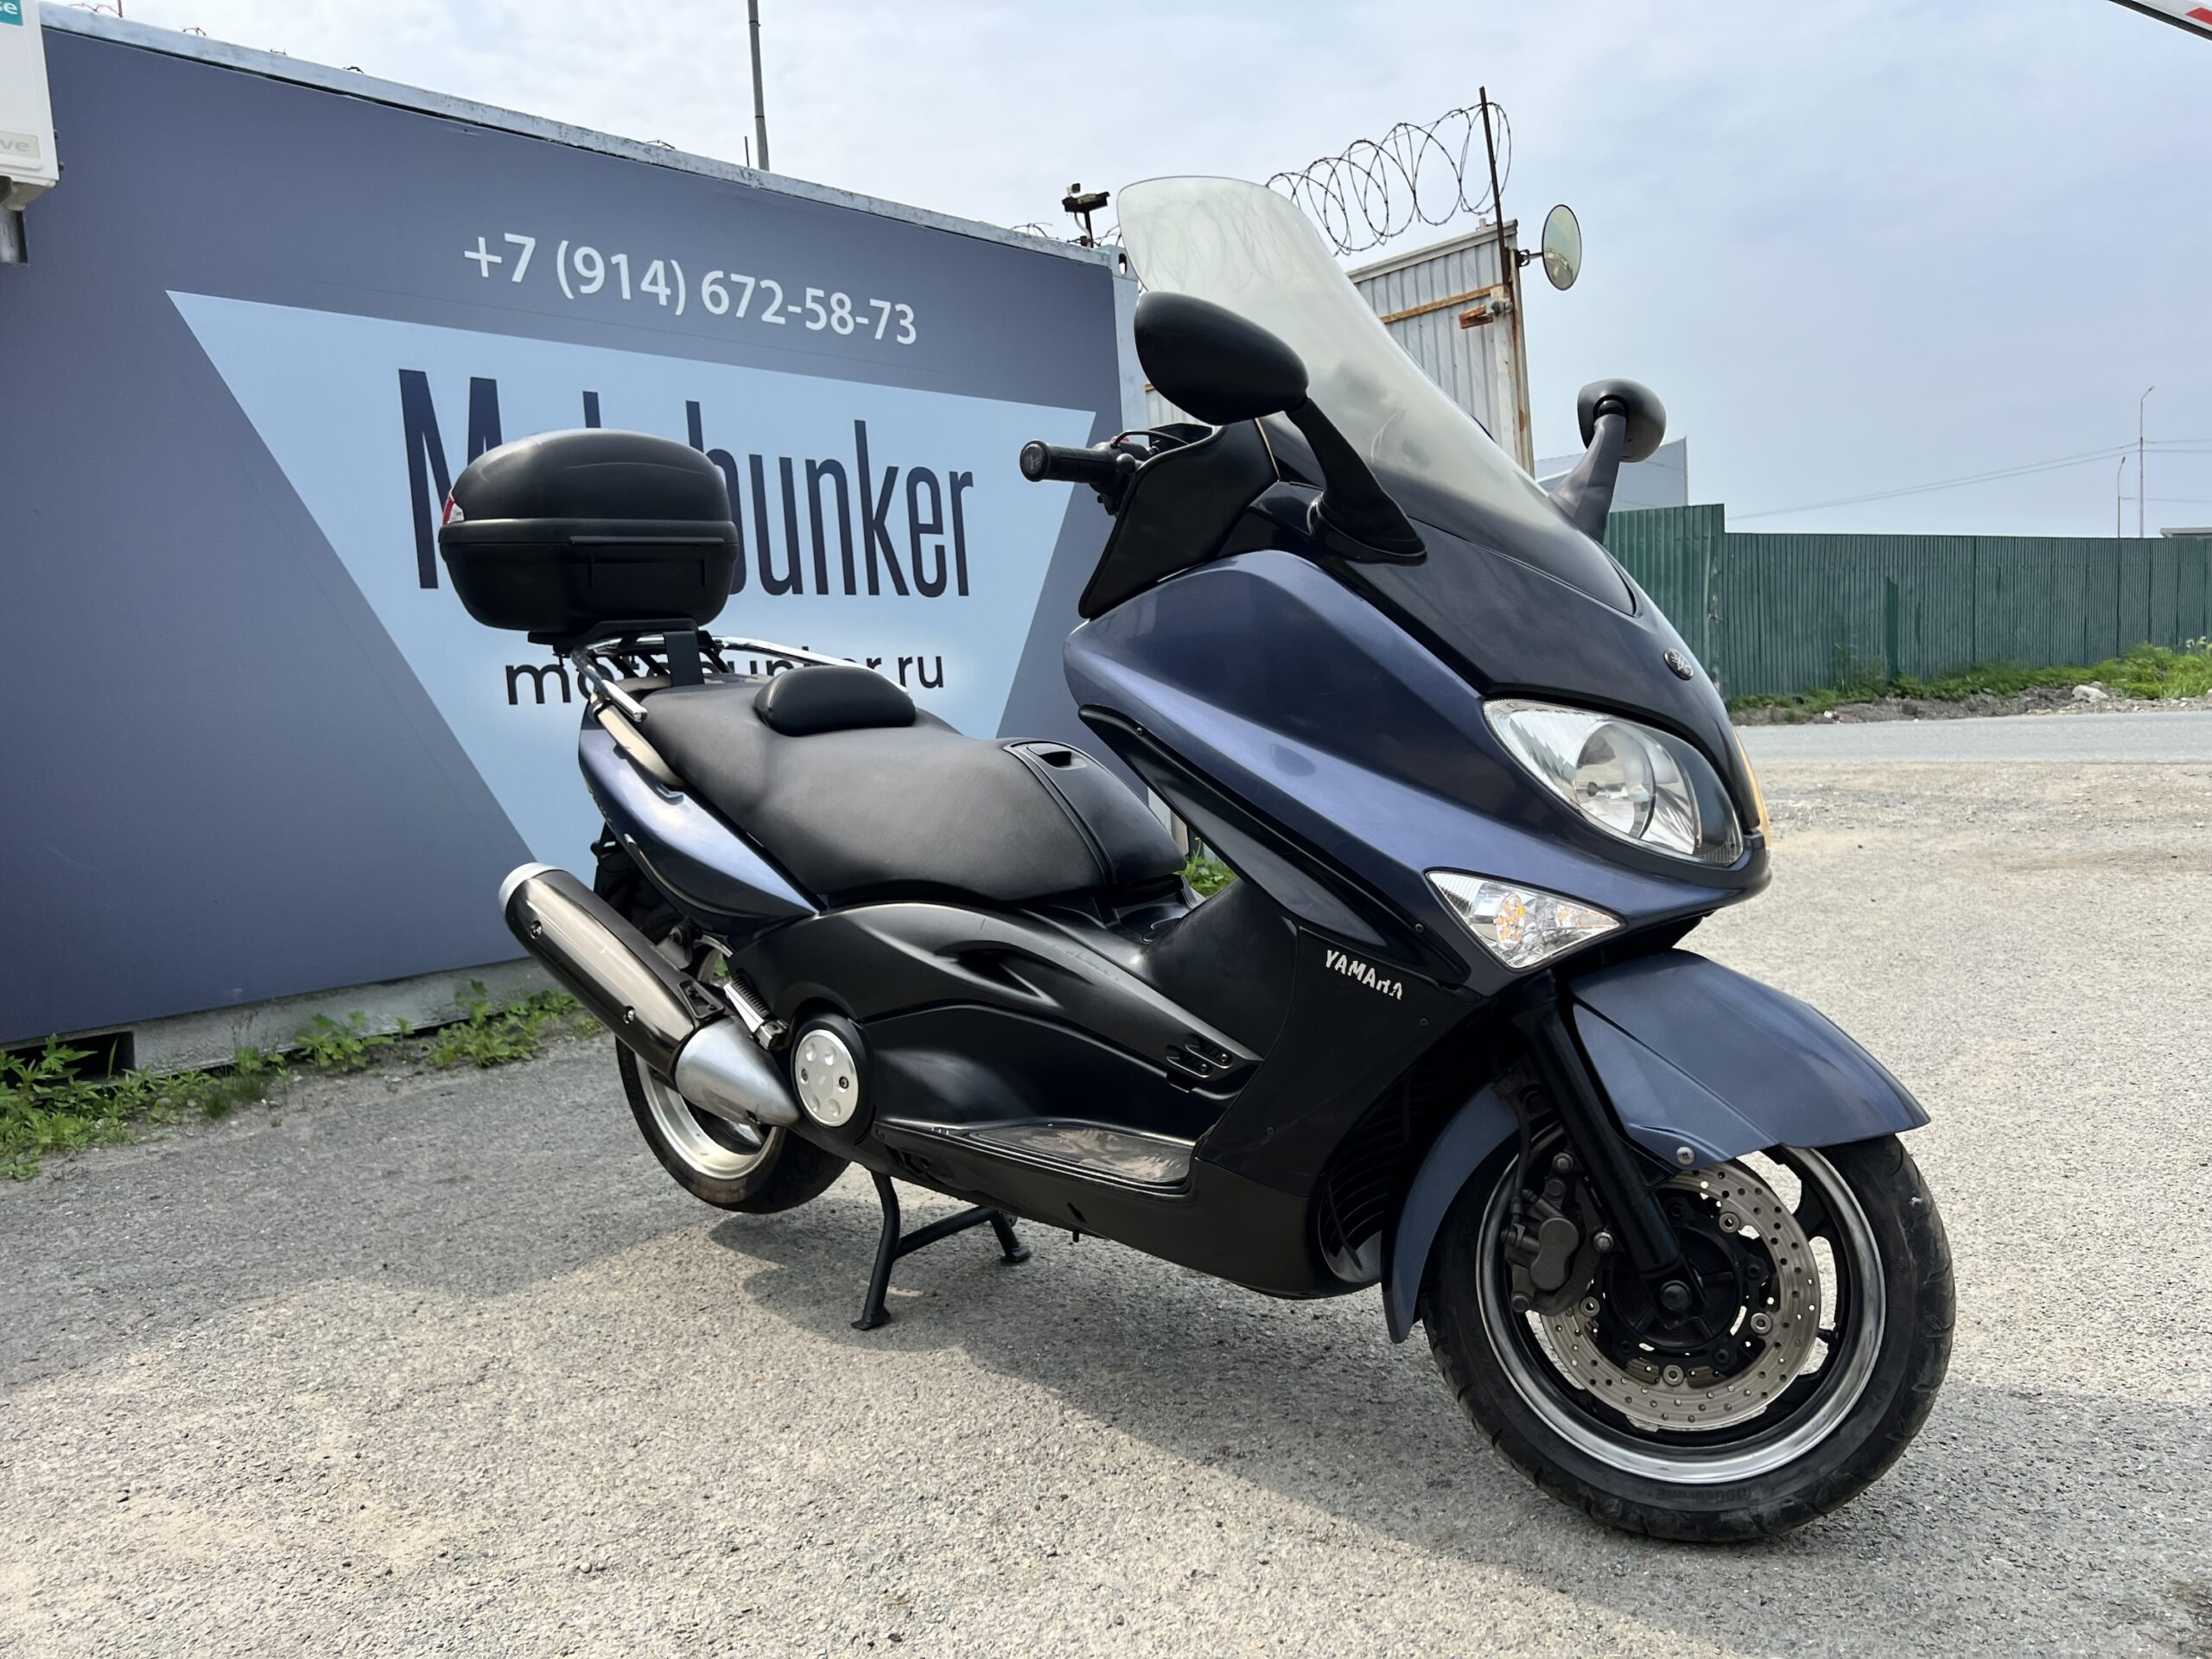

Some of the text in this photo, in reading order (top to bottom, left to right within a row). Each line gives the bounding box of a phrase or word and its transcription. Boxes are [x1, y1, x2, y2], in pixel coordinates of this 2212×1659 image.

[464, 233, 918, 345] +7 (914) 672-58-73
